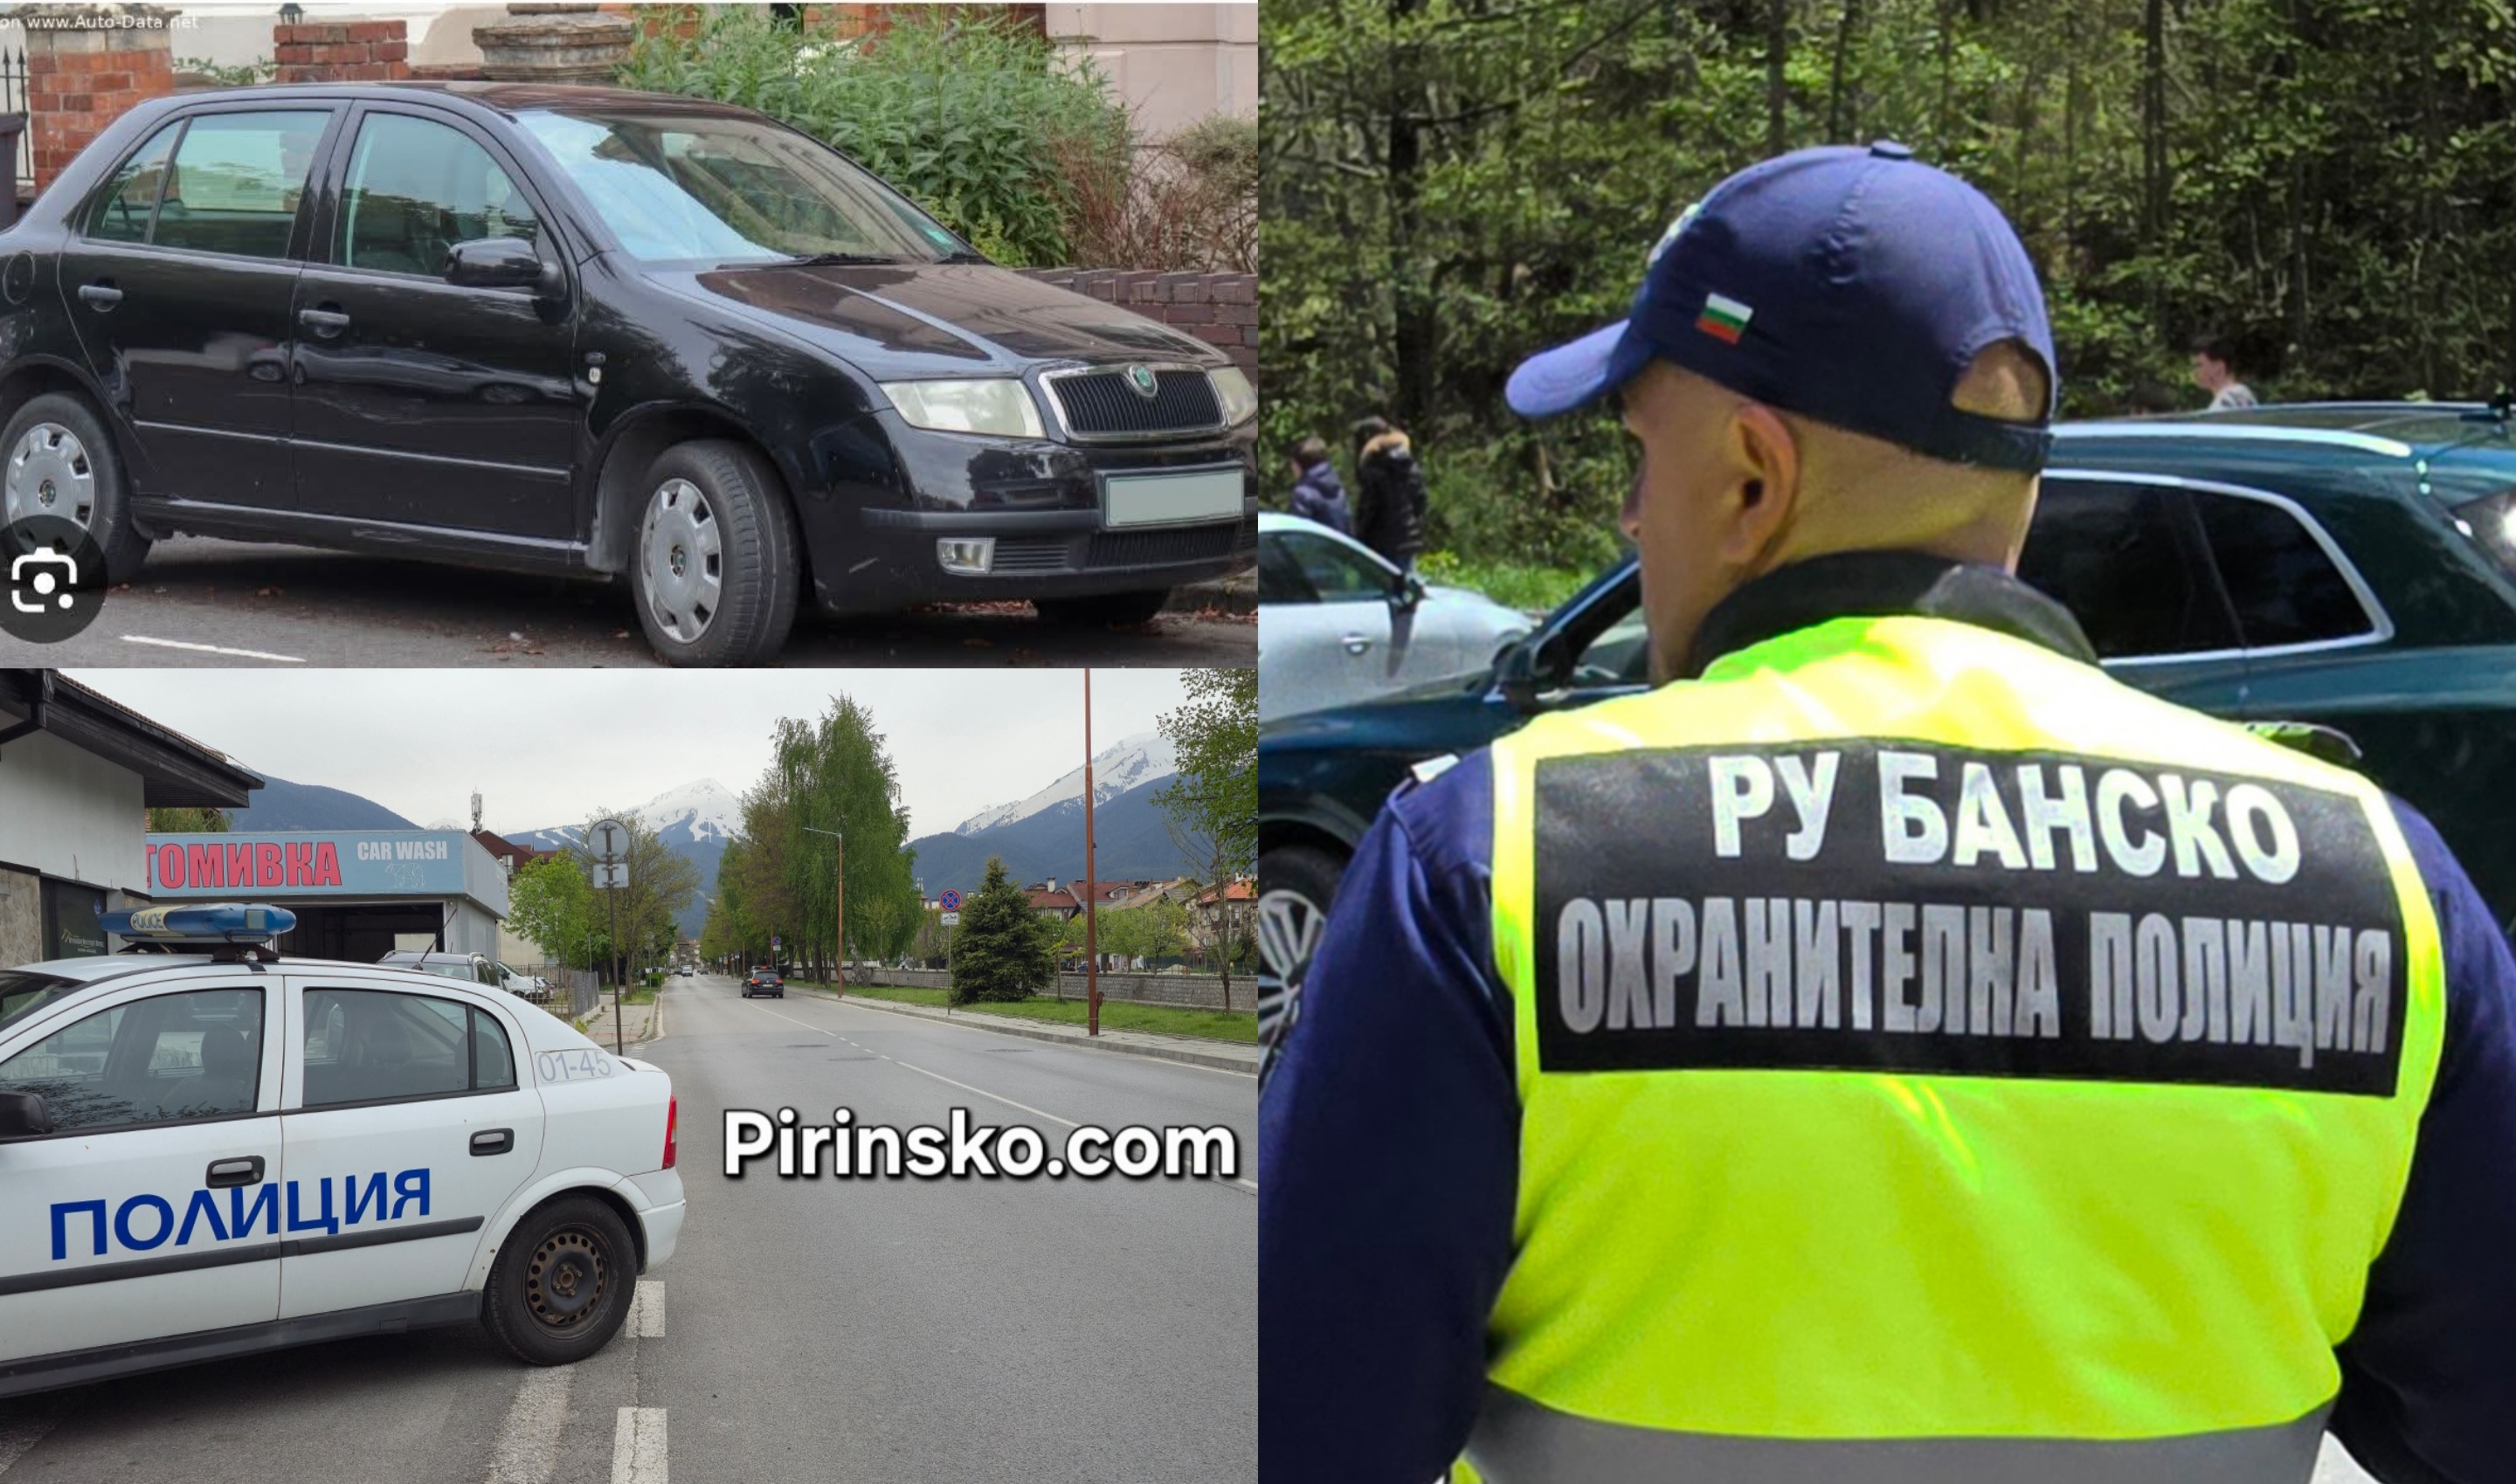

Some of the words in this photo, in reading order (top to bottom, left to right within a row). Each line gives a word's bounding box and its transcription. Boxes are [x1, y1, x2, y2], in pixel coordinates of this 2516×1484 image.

[1707, 750, 1840, 860] РУ
[1877, 751, 2301, 884] БАНСКО
[356, 841, 392, 860] CAR
[397, 841, 447, 859] WASH
[132, 913, 163, 928] POLICE
[1558, 896, 2060, 1038] ОХРАНИТЕЛНА
[2090, 911, 2391, 1068] ПОЛИЦИЯ
[537, 1049, 612, 1082] 01-45
[50, 1168, 431, 1260] ПОЛИЦИЯ
